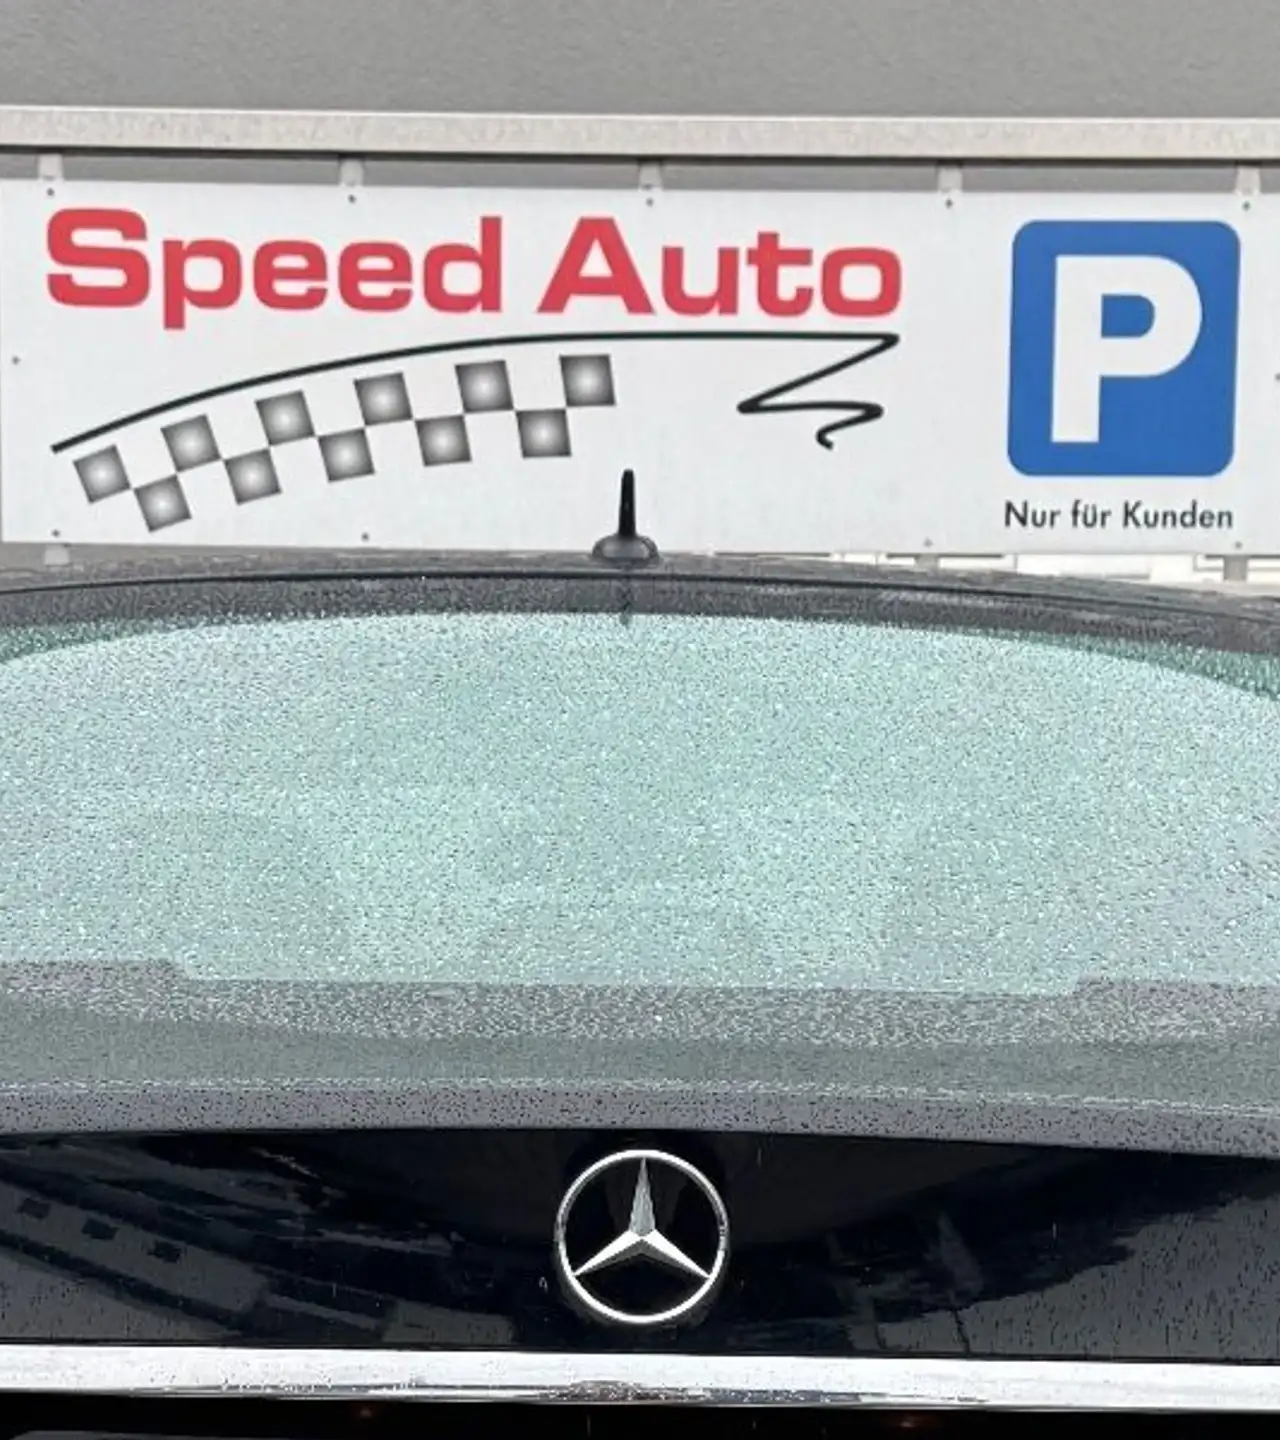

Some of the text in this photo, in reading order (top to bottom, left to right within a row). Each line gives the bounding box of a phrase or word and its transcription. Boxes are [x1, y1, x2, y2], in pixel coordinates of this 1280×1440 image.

[46, 207, 902, 330] Speed Auto
[1051, 254, 1203, 444] P
[1005, 499, 1233, 529] Nur für Kunden
